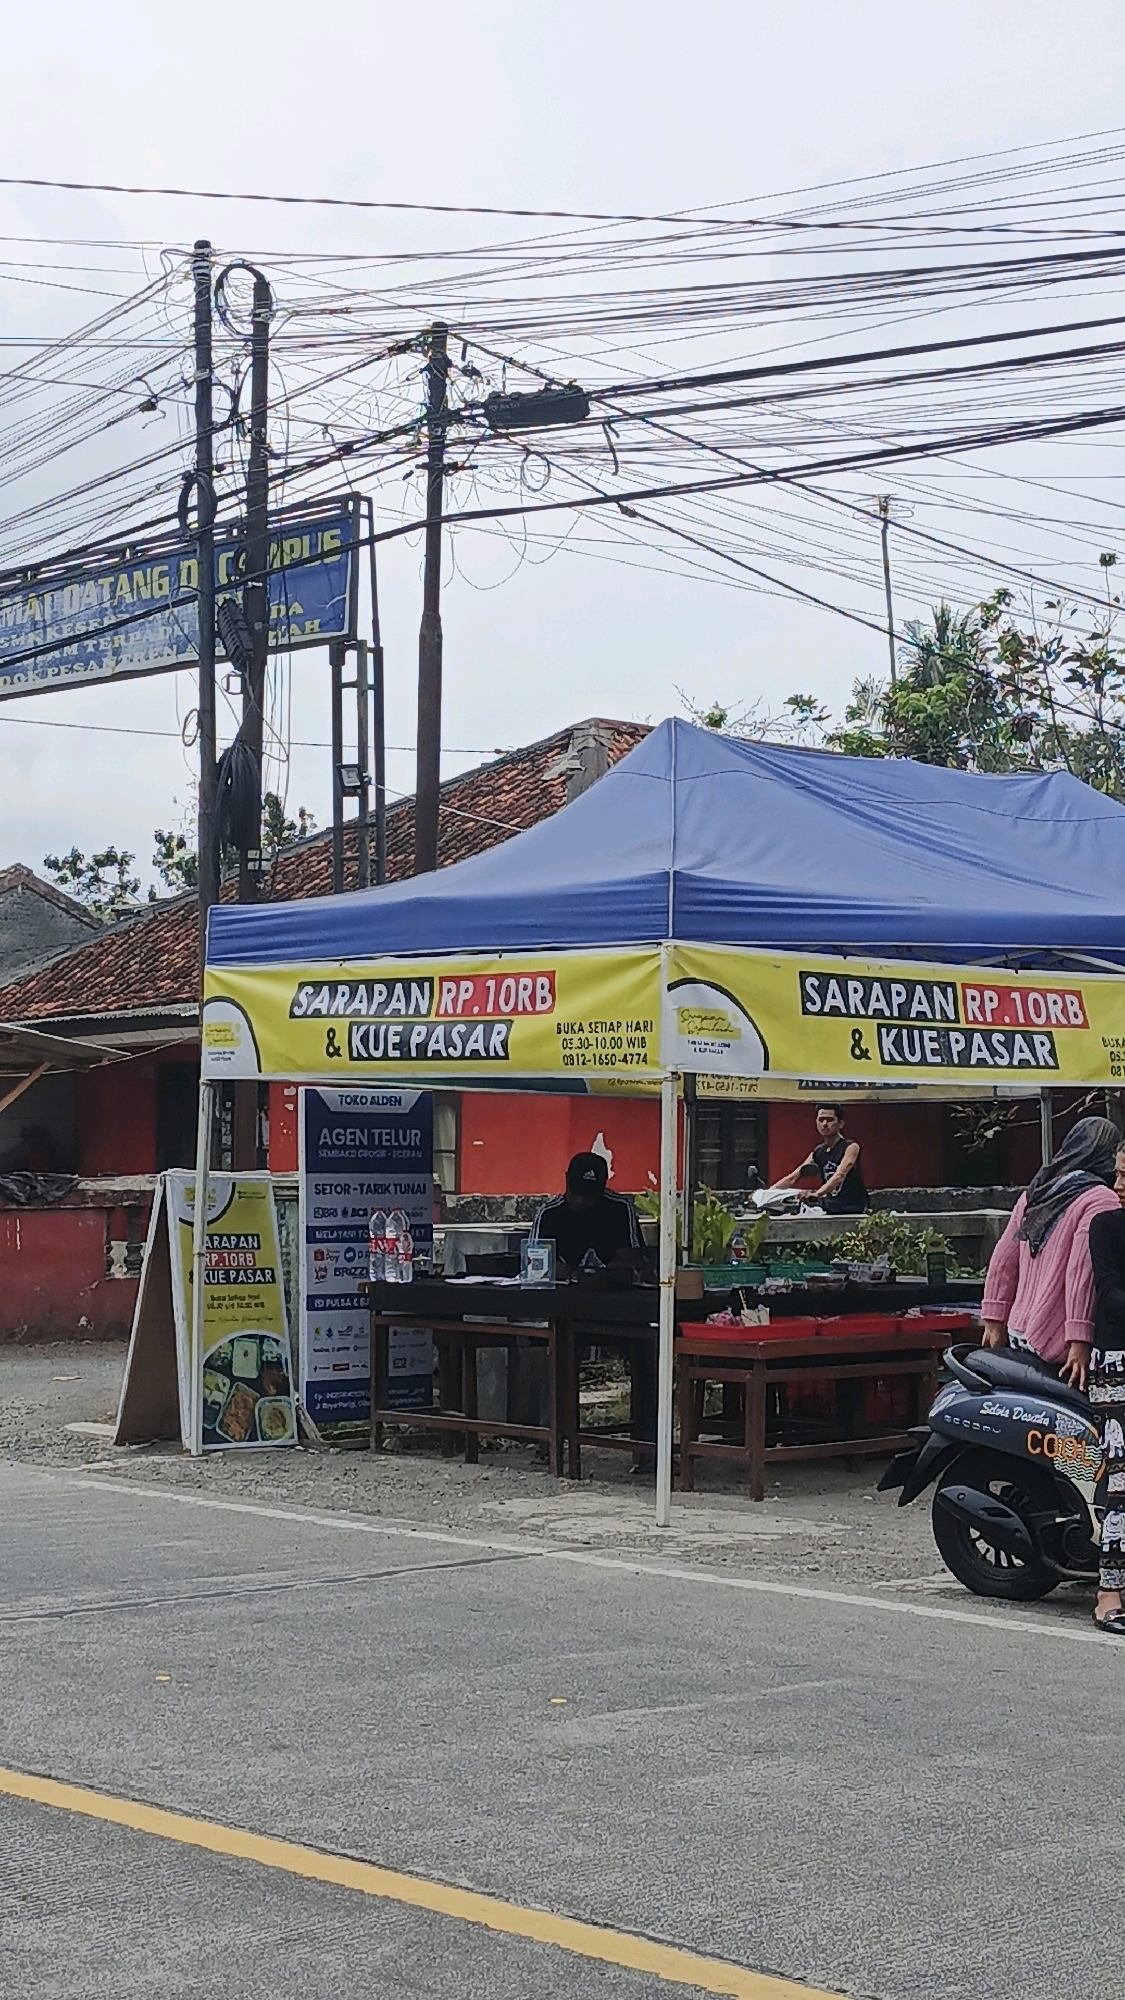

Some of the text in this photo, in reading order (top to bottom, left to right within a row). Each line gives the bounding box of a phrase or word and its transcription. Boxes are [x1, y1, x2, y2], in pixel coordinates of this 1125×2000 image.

[64, 565, 170, 617] DATANG
[292, 976, 553, 1016] SARAPAN RP.10RB
[803, 976, 1084, 1026] SARAPAN RP.10RB
[556, 1020, 653, 1035] BUKA SETIAP HARI
[326, 1022, 508, 1058] & KUE PASAR
[626, 1036, 647, 1049] WIB
[851, 1027, 1056, 1067] & KUE PASAR
[563, 1052, 648, 1066] 0812-1650-4774
[338, 1094, 402, 1107] TOKO ALDEN
[319, 1128, 422, 1147] AGEN TELUR
[393, 1183, 427, 1195] TUNAI
[205, 1235, 258, 1249] ARAPAN
[230, 1269, 273, 1283] PASAR
